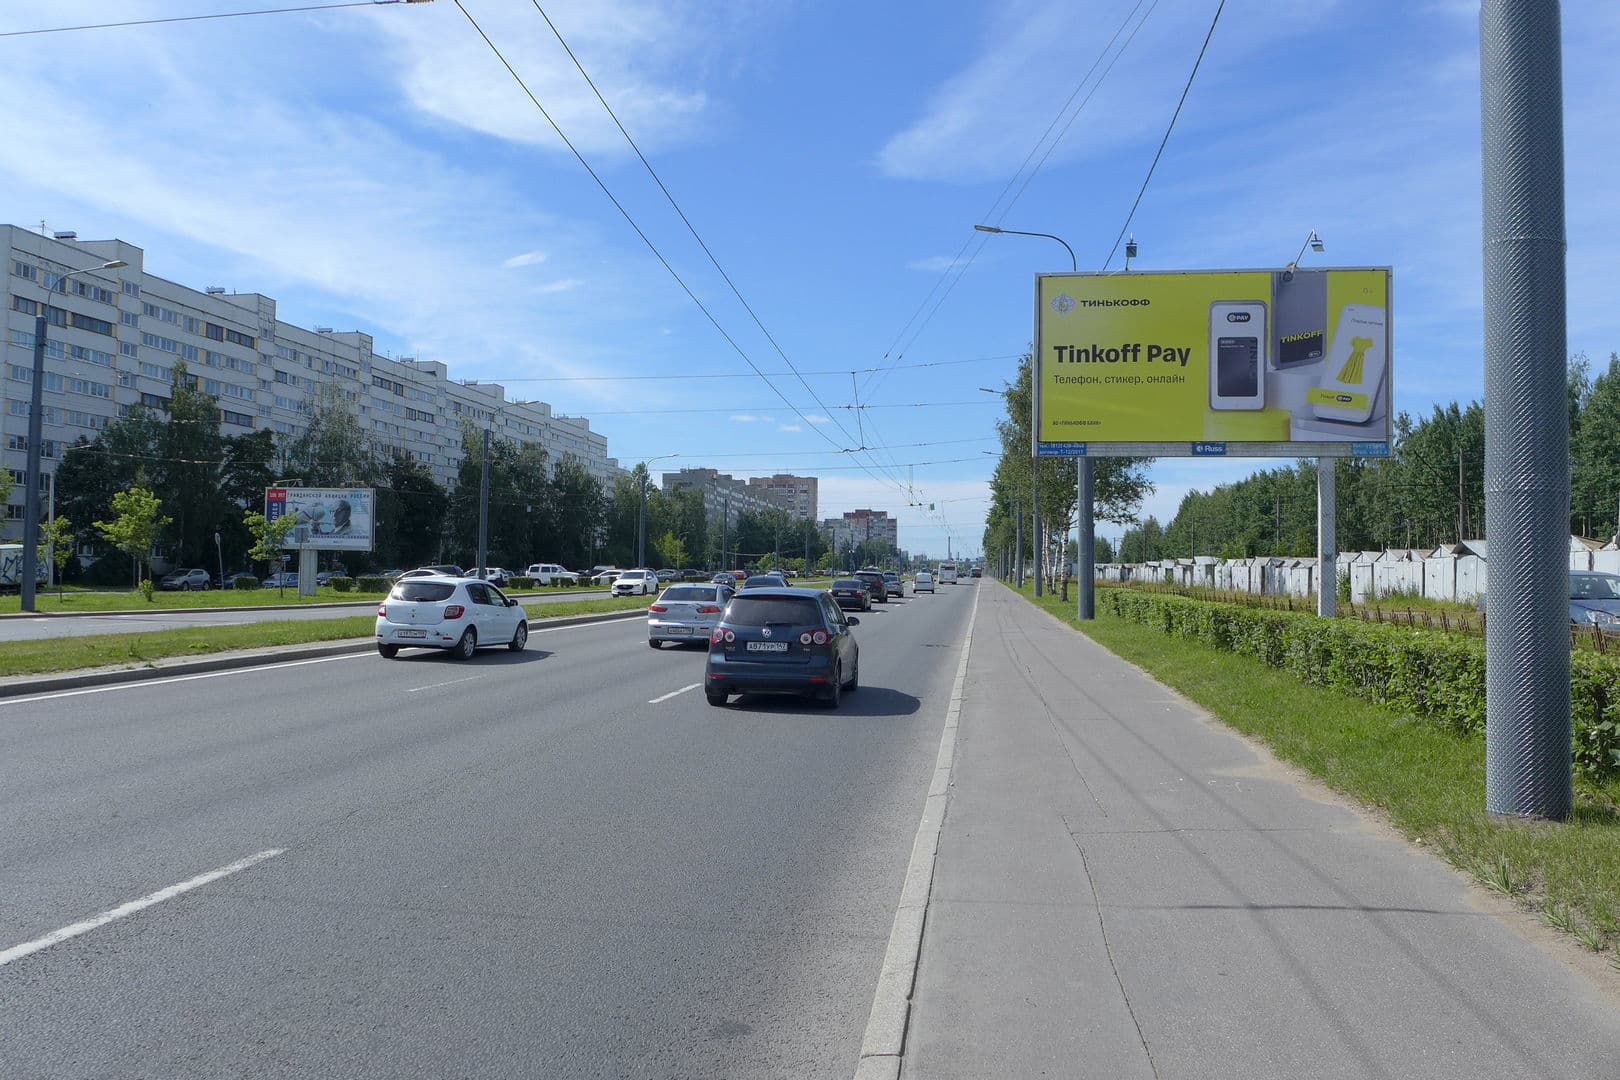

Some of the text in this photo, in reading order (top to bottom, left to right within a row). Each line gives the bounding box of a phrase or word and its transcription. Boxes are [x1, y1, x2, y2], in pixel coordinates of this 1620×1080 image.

[1081, 298, 1151, 307] ТИНЬКОФФ
[1280, 329, 1323, 344] TINKOFF
[1053, 344, 1192, 367] Tinkoff Pay
[1053, 374, 1185, 386] Телефон, стикер, онлайн
[1204, 444, 1223, 453] Russ
